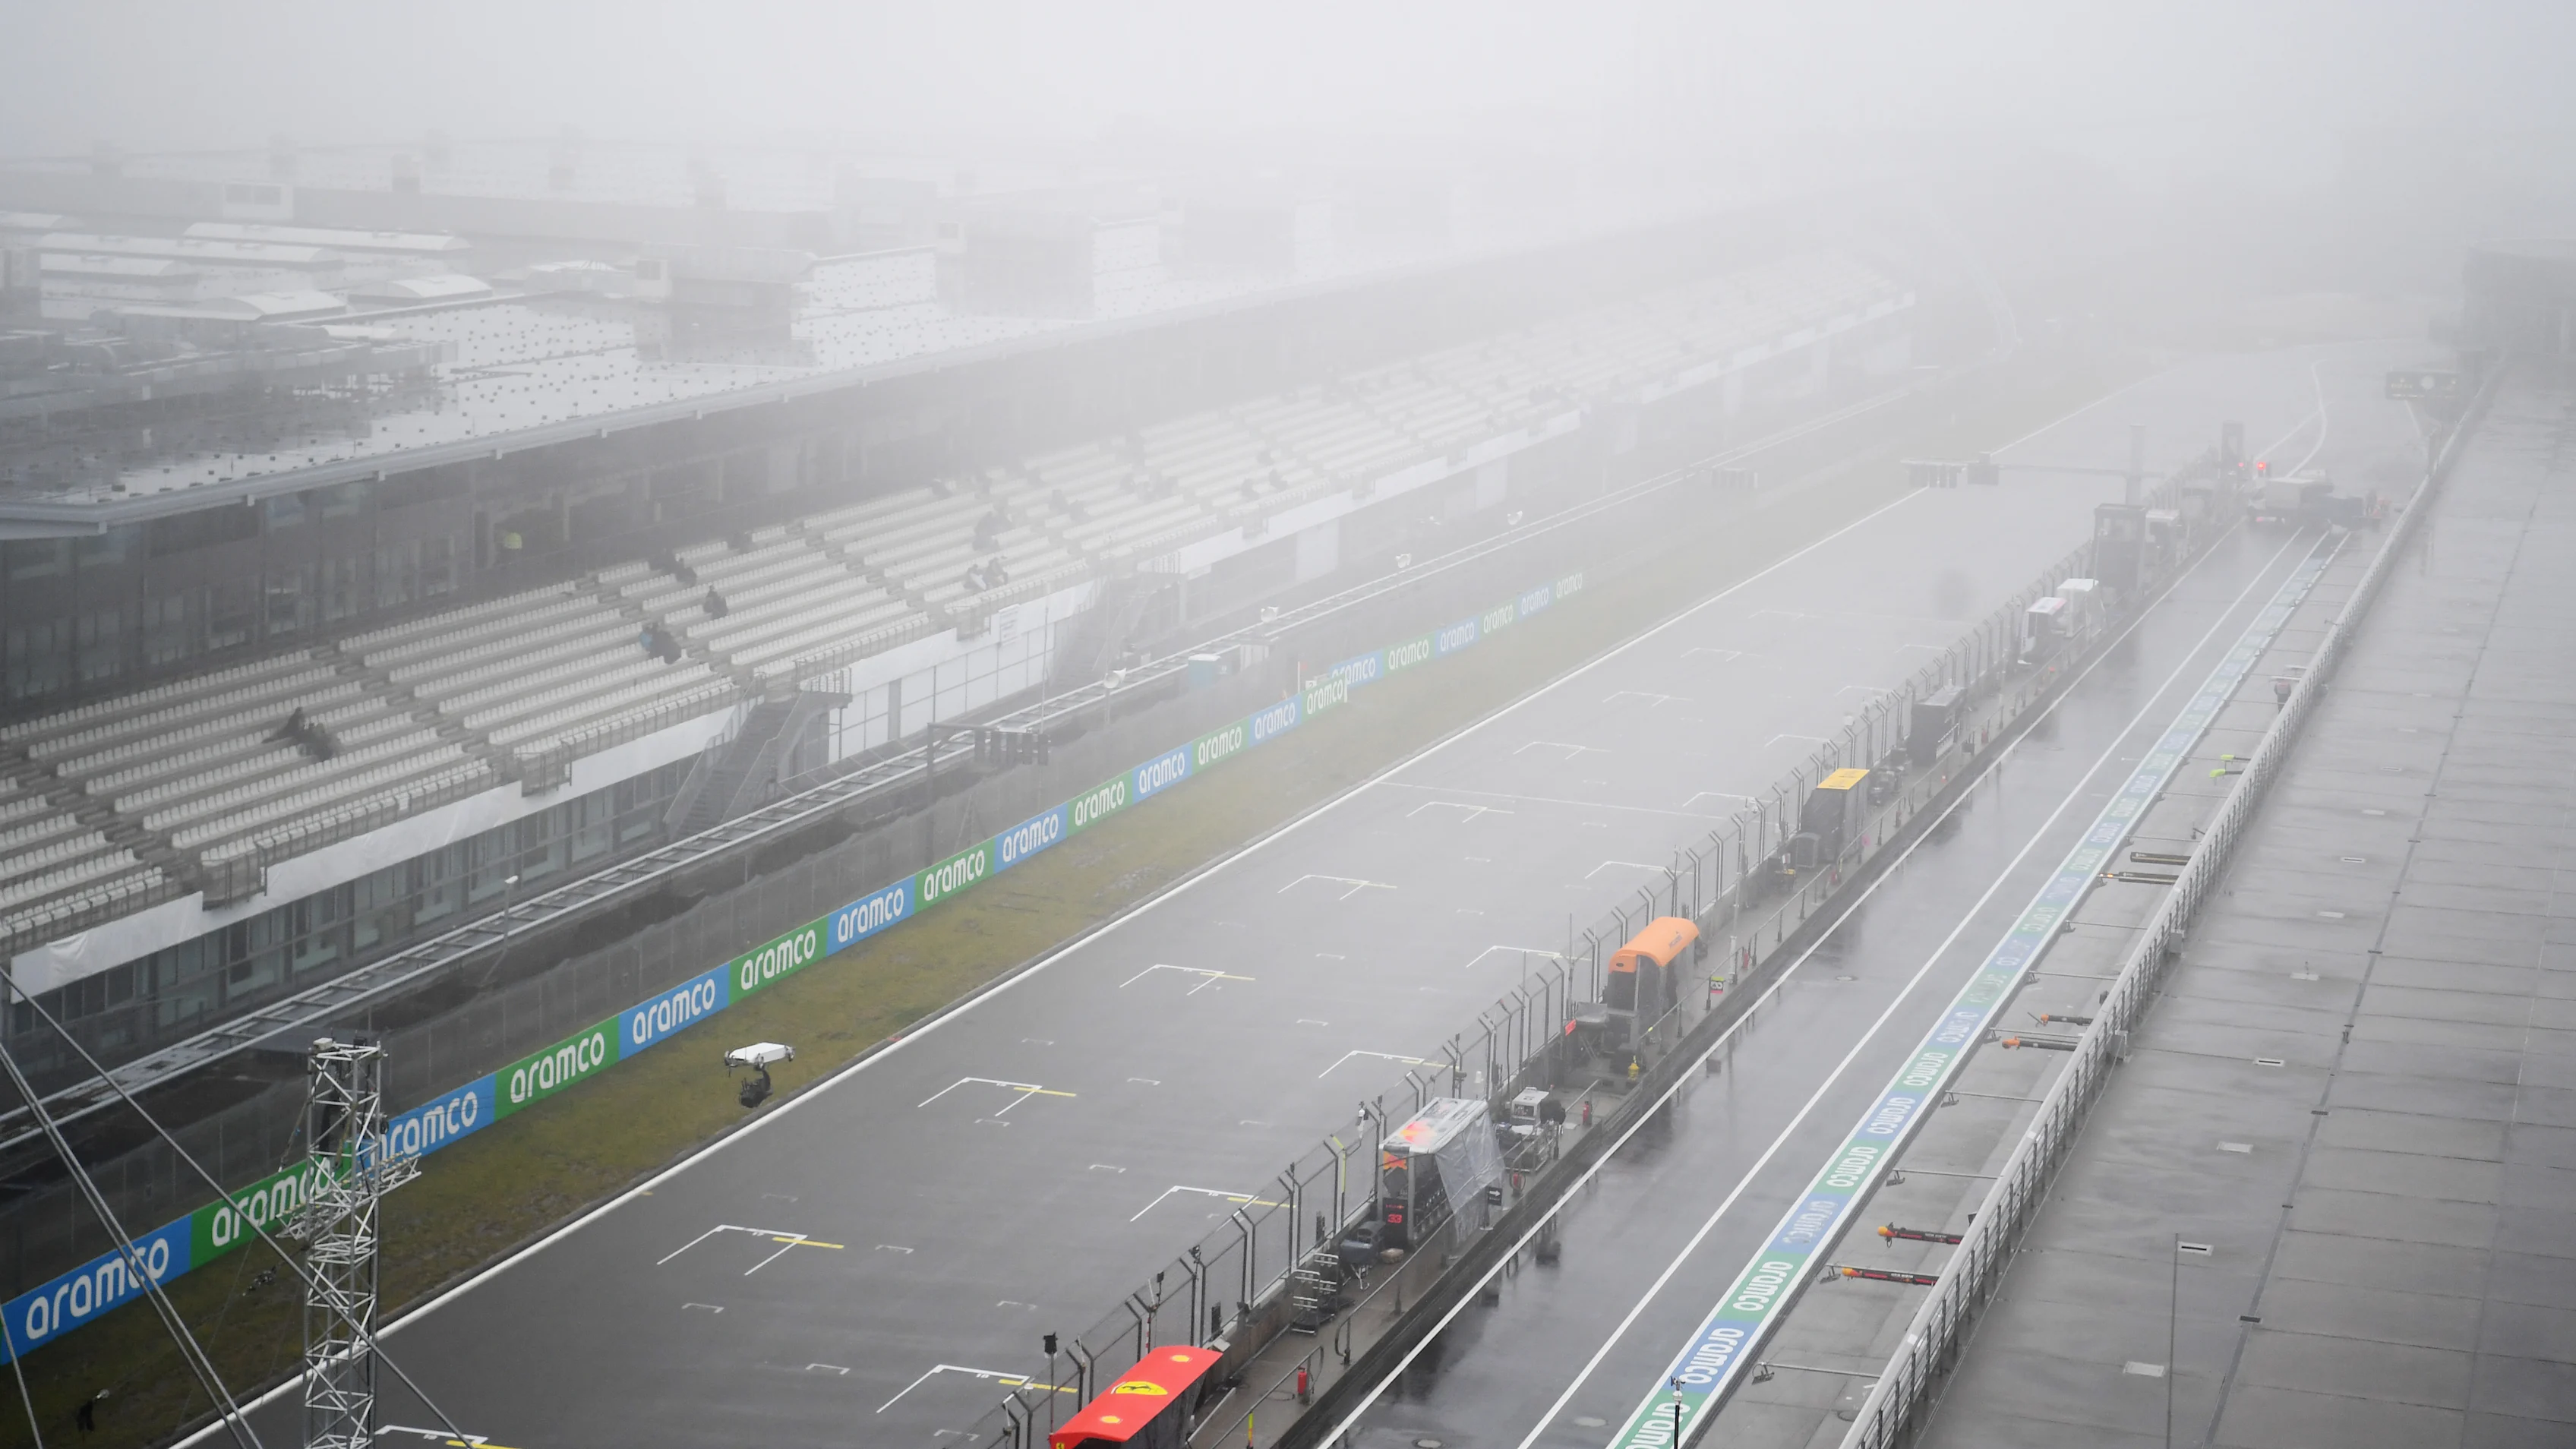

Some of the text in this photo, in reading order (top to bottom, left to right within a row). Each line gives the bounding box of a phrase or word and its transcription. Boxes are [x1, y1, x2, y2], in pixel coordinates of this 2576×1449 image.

[1483, 605, 1513, 633] aramco
[1521, 588, 1549, 614] aramco
[1388, 639, 1428, 670] aramco
[1440, 621, 1474, 652] aramco
[1332, 657, 1375, 684] amco
[1307, 679, 1343, 714] aramco
[1255, 702, 1295, 739] aramco
[1198, 727, 1242, 765] aramco
[1139, 753, 1185, 794] aramco
[1075, 781, 1124, 826] aramco
[1002, 814, 1058, 863] aramco
[924, 848, 984, 901] aramco
[838, 889, 903, 942] aramco
[741, 930, 815, 990] aramco
[633, 979, 715, 1044] aramco
[511, 1032, 604, 1103] aramco
[1903, 1053, 1949, 1086] aramco
[1866, 1097, 1915, 1134] aramco
[1826, 1147, 1878, 1187] aramco
[27, 1238, 169, 1339] aramco
[1733, 1261, 1793, 1312] aramco
[1678, 1327, 1744, 1384] aramco
